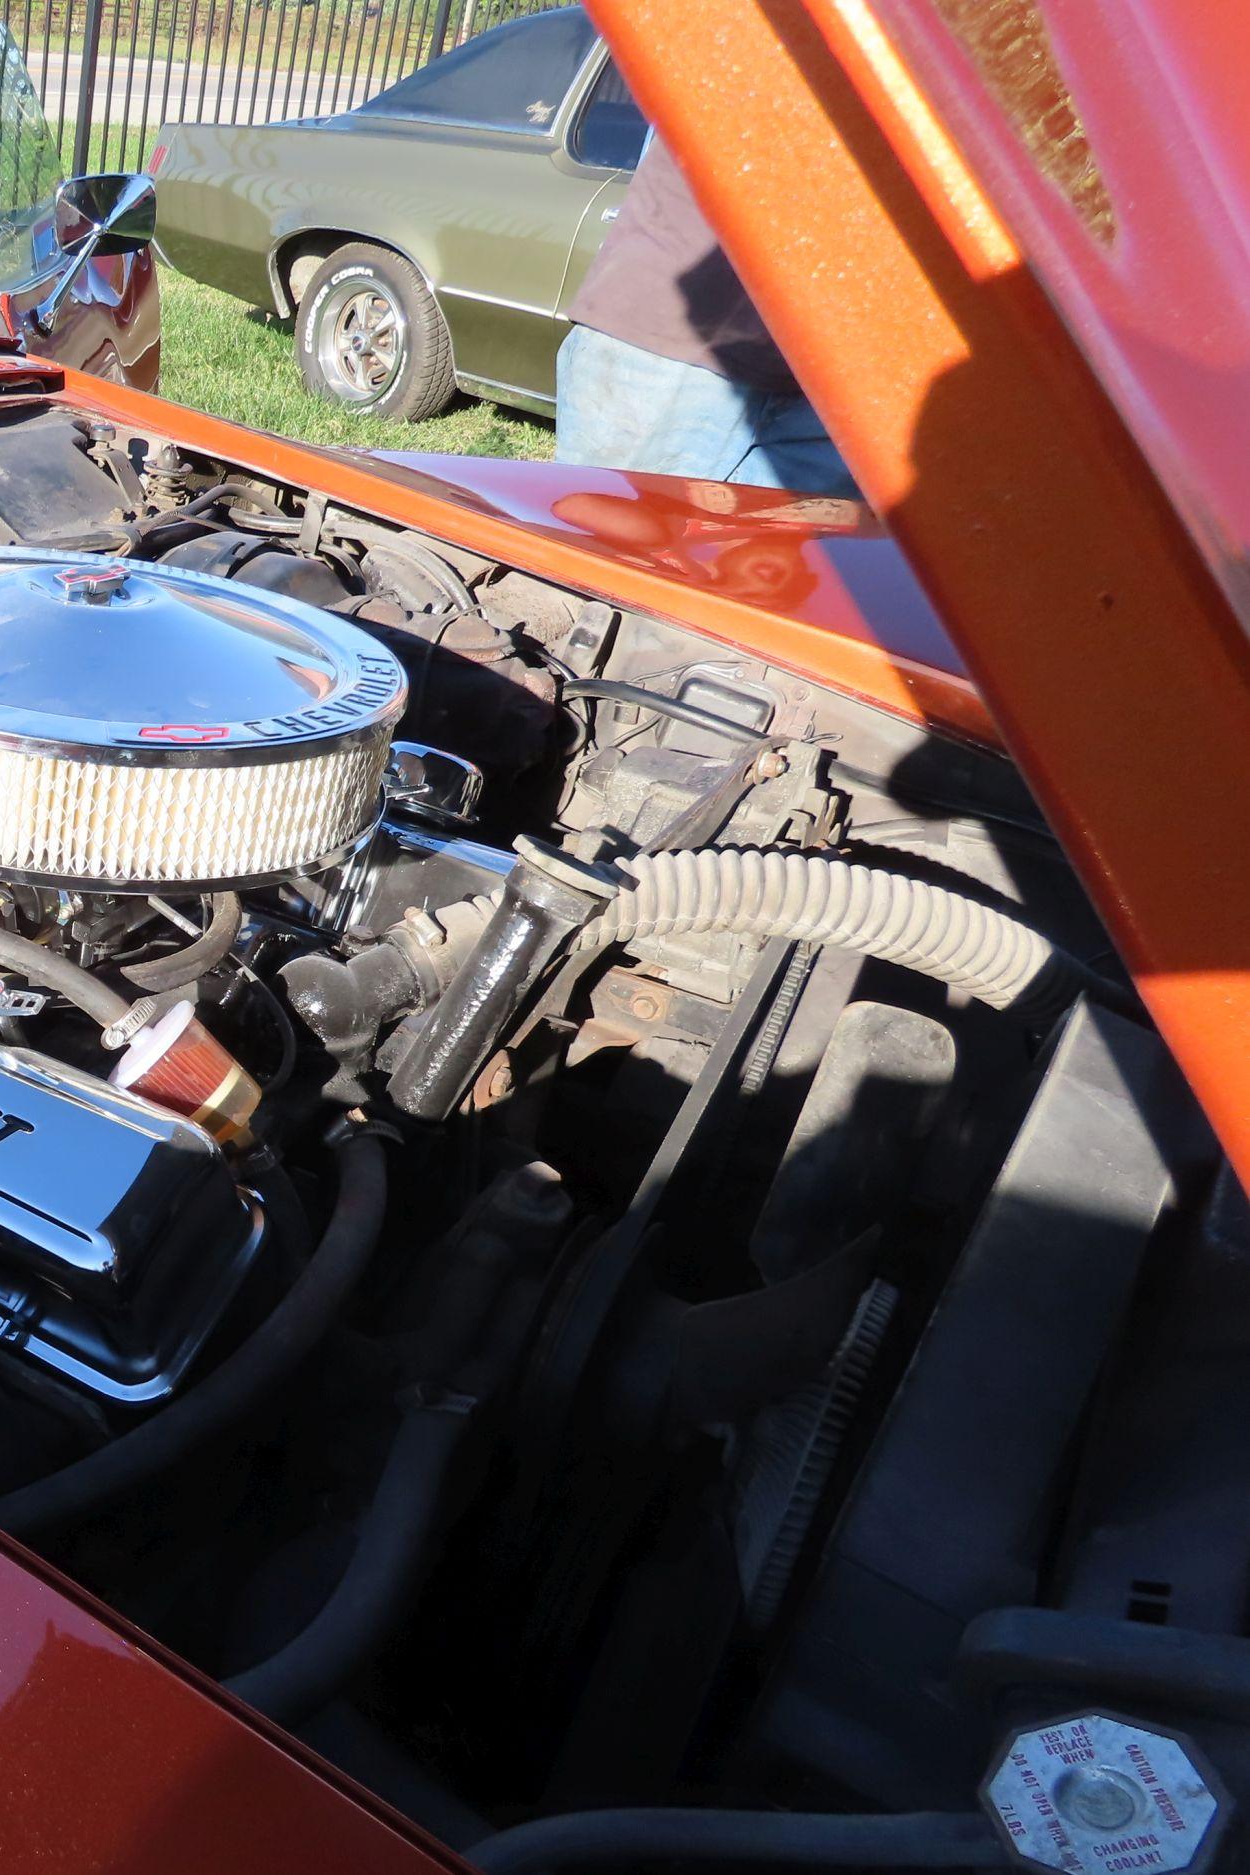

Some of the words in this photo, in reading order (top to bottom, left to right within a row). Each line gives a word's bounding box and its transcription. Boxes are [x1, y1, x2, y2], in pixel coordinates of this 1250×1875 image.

[304, 284, 330, 353] COOPER
[331, 266, 374, 285] COBRA
[243, 653, 398, 737] CHEVROLET
[1038, 1730, 1066, 1744] TEST
[1071, 1724, 1088, 1737] OR
[1044, 1735, 1094, 1755] REPLACE
[1060, 1749, 1095, 1765] WHEN
[1010, 1753, 1028, 1766] DO
[1020, 1770, 1040, 1788] NOT
[1032, 1792, 1054, 1816] OPEN
[1125, 1744, 1158, 1784] CAUTION
[1150, 1788, 1186, 1832] PRESSURE
[1092, 1834, 1160, 1857] CHANGING
[1105, 1850, 1164, 1873] COOLANT
